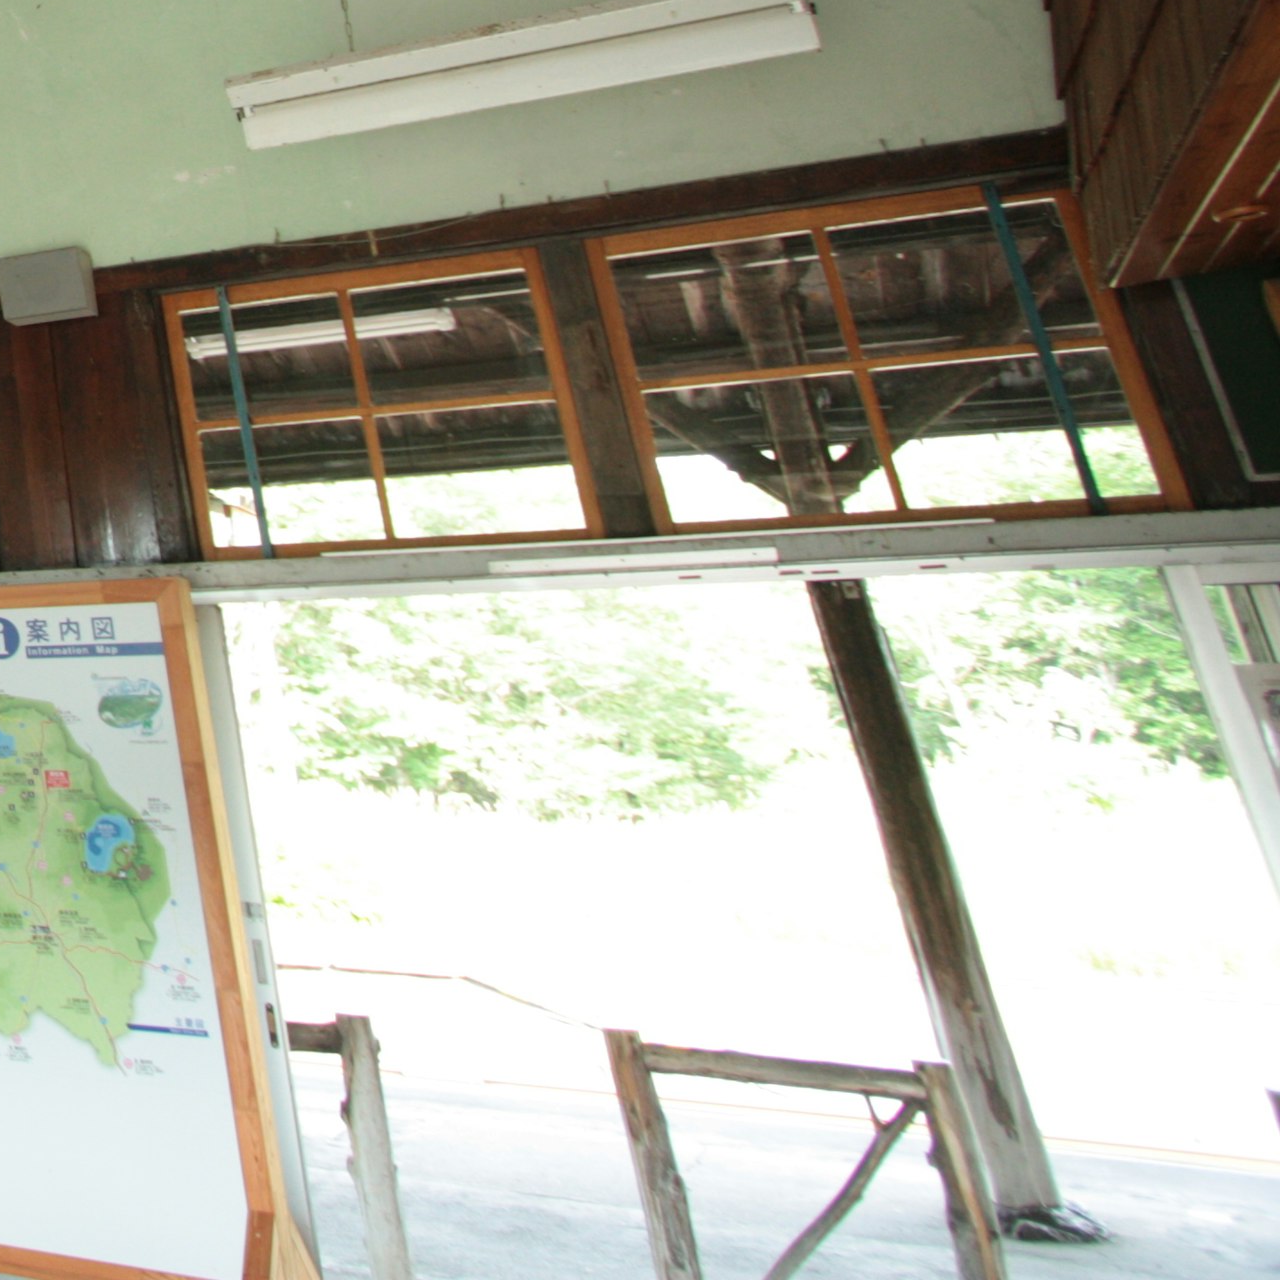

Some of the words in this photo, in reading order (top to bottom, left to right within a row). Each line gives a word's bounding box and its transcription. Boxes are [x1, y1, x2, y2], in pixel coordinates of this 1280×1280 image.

[25, 616, 116, 643] 案内図
[26, 645, 90, 657] Information
[95, 644, 119, 657] Map
